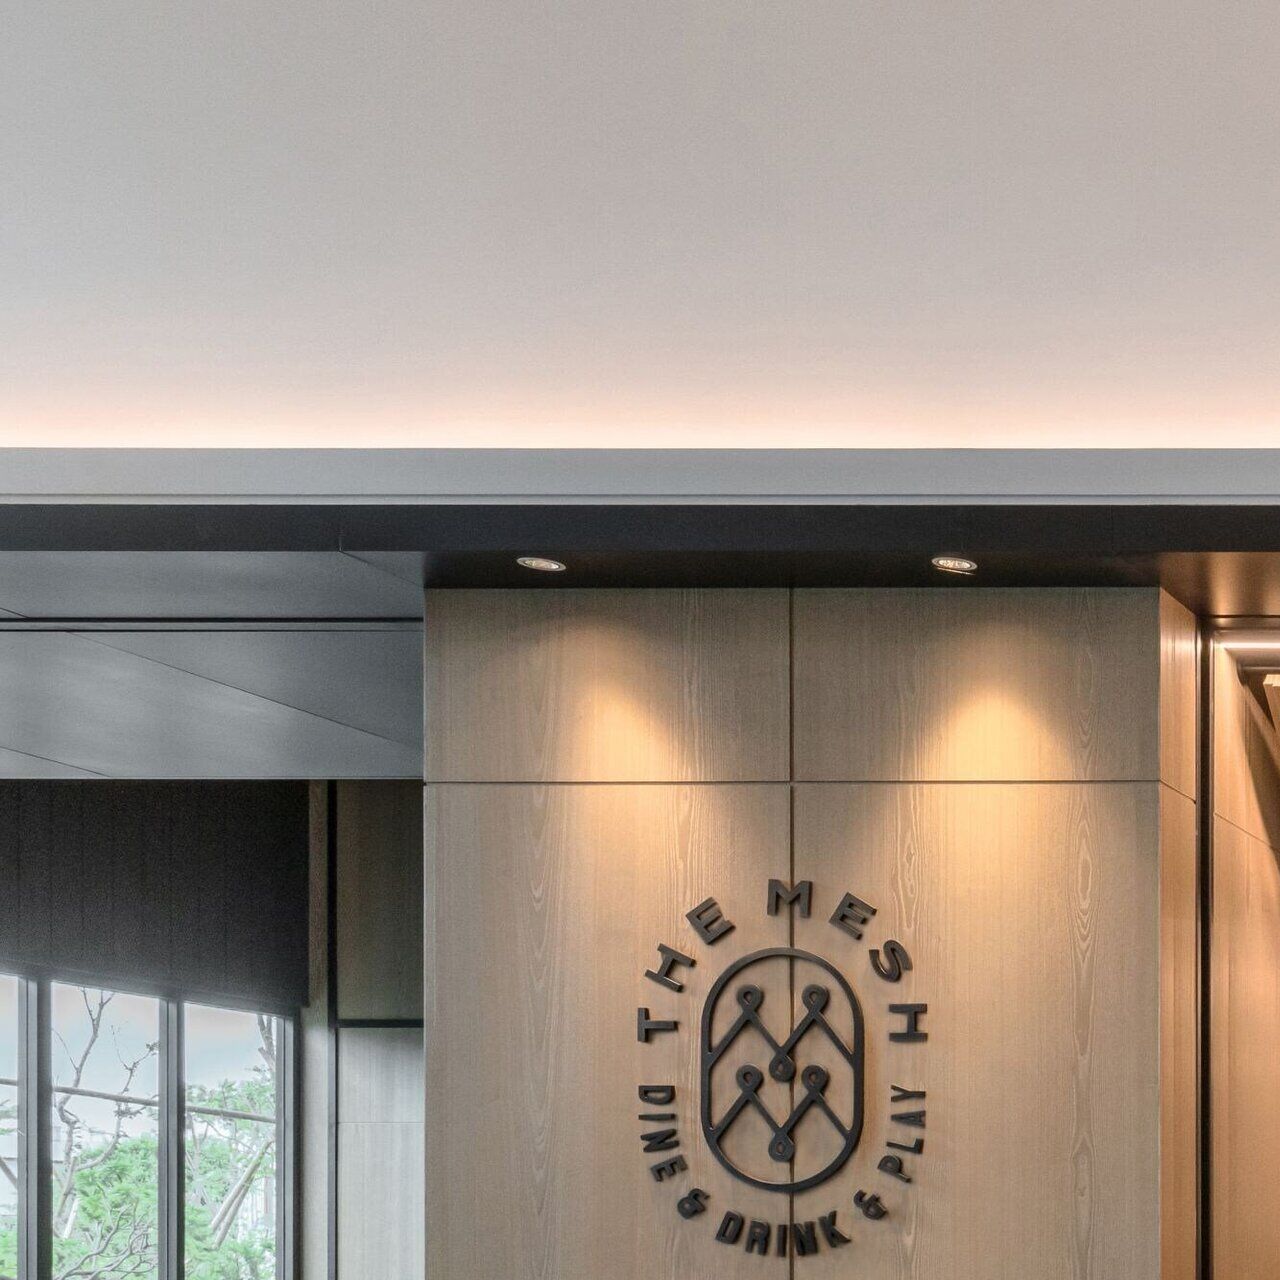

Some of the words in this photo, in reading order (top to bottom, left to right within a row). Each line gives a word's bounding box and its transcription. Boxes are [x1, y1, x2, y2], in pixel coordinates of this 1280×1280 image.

[637, 897, 736, 1043] THE
[767, 879, 928, 1043] MESH
[638, 1085, 688, 1182] DINE
[677, 1187, 710, 1220] &
[715, 1210, 852, 1258] DRINK
[853, 1189, 889, 1221] &
[877, 1084, 926, 1183] PLAY
